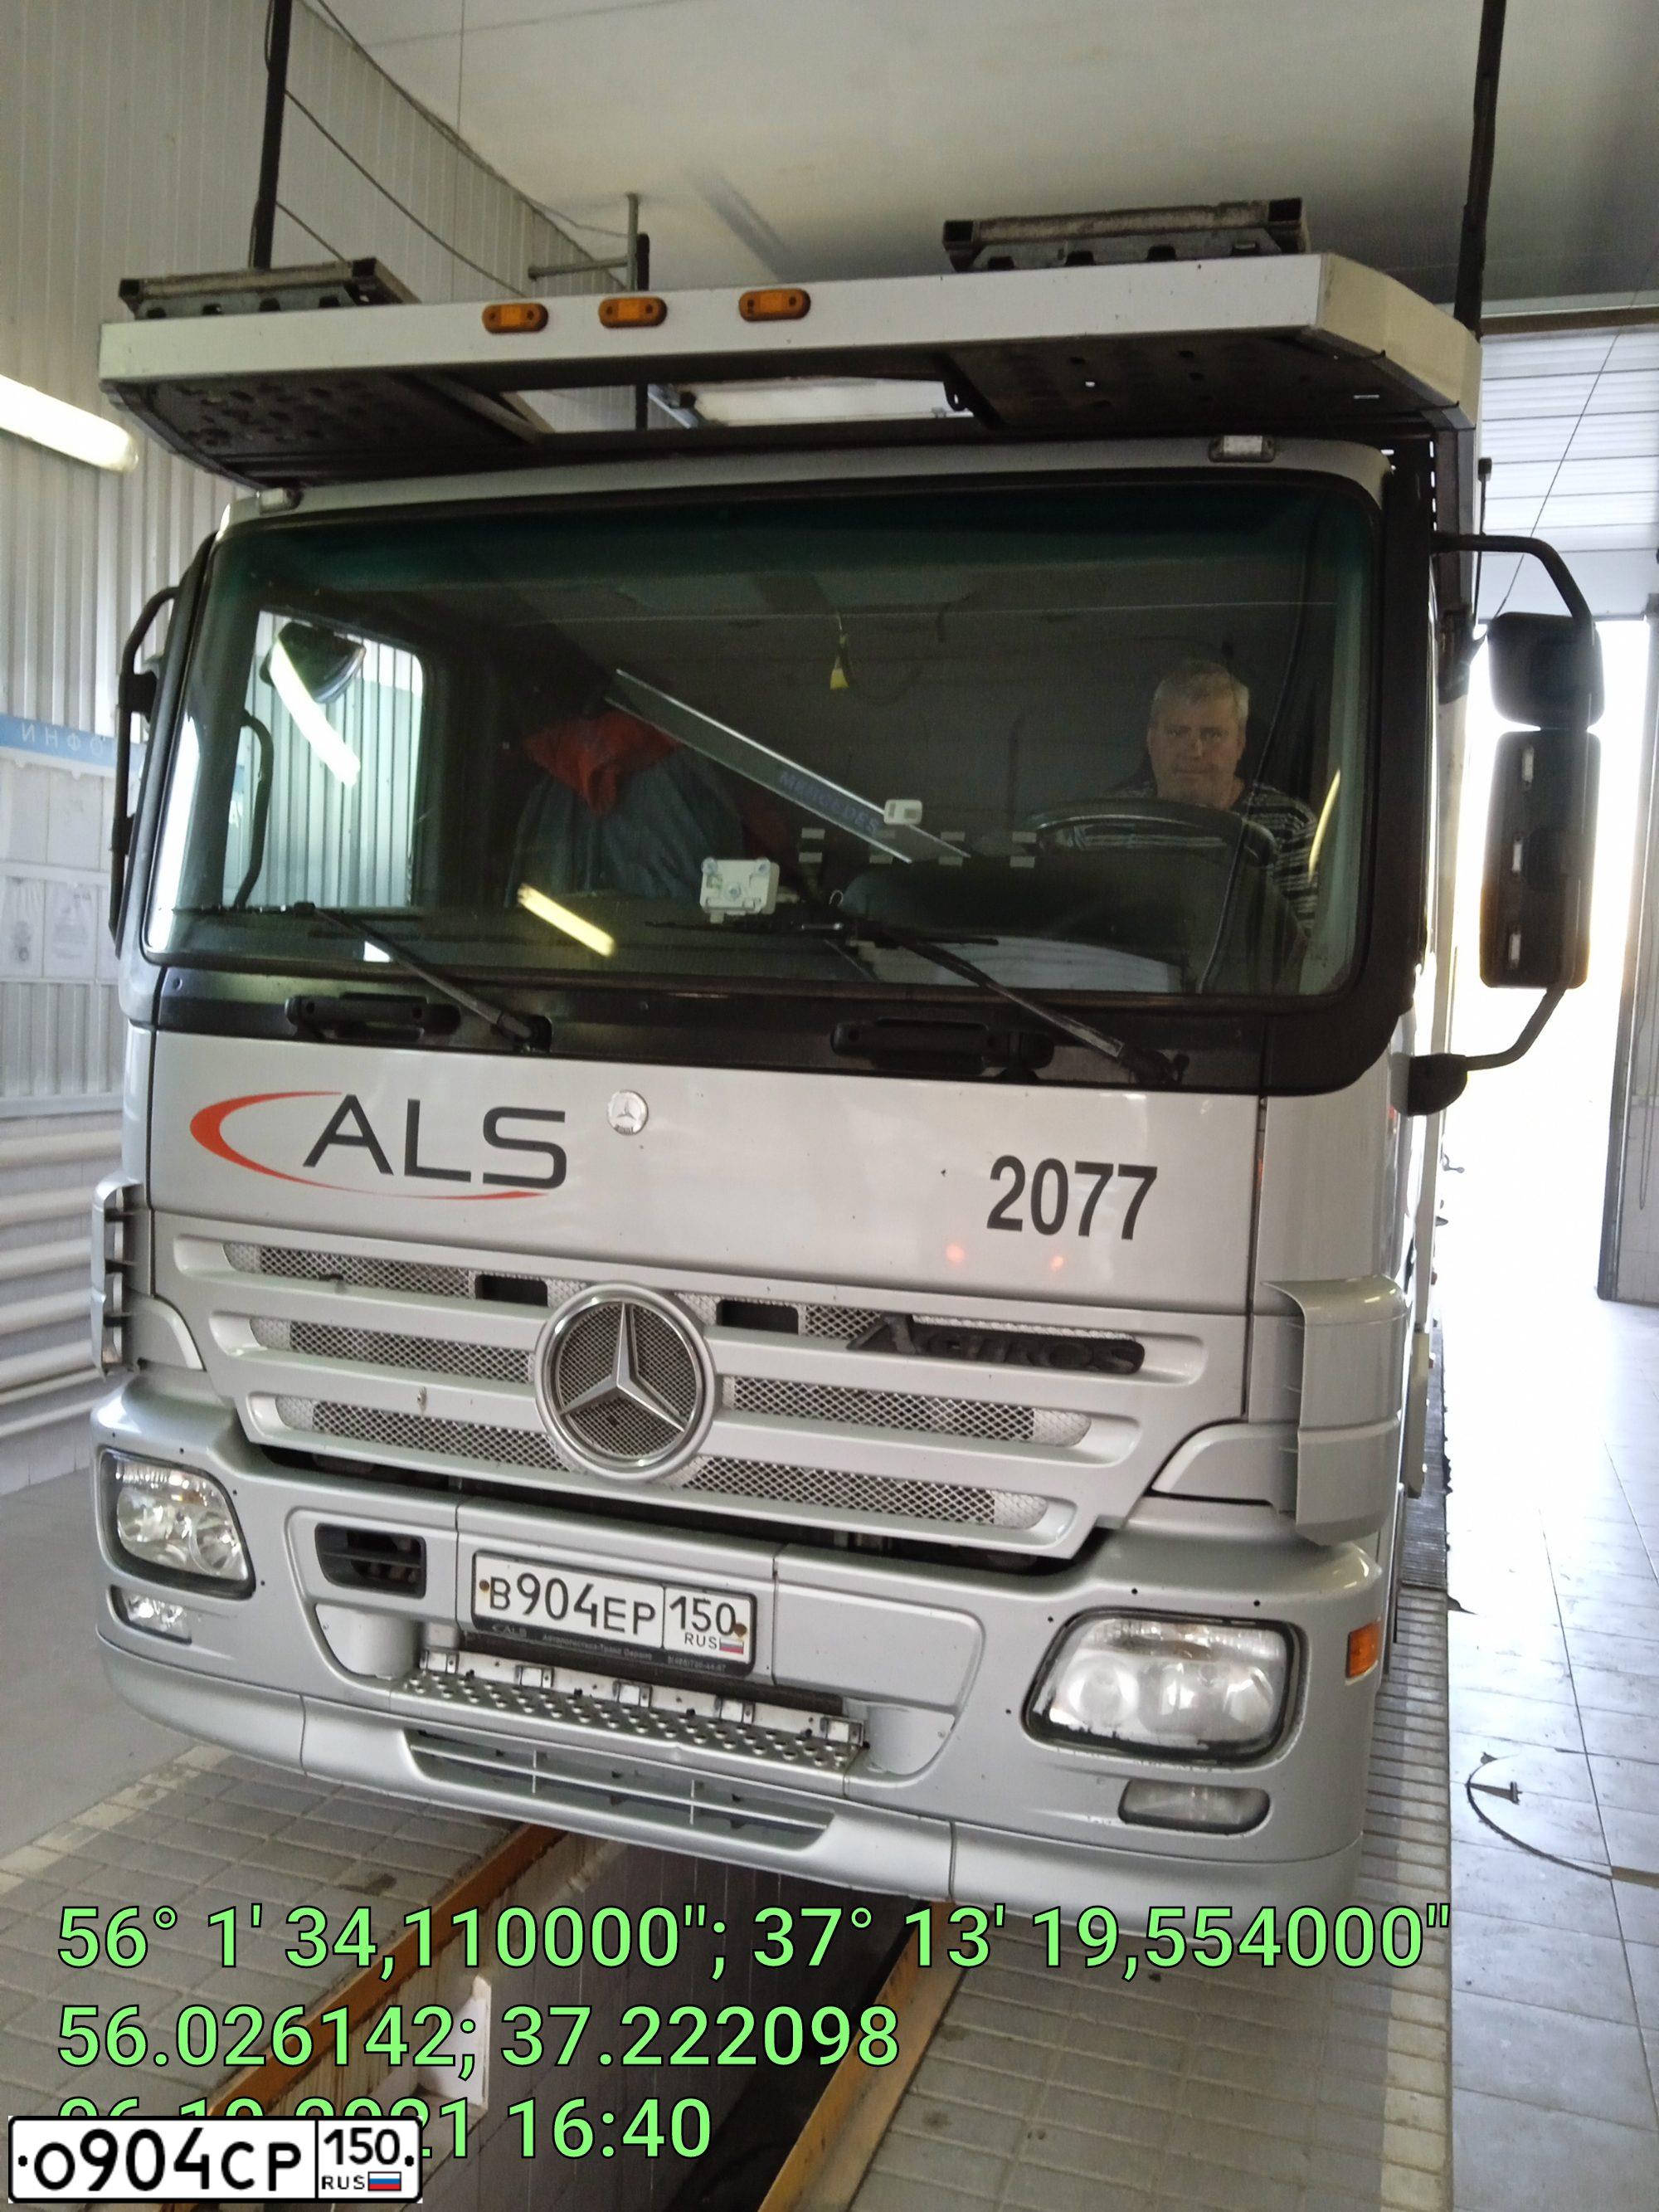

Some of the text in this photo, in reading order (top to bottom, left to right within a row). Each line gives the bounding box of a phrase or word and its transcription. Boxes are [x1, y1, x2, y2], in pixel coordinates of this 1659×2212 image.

[302, 1094, 567, 1190] ALS
[986, 1154, 1158, 1240] 2077
[669, 1595, 737, 1637] 150
[684, 1631, 718, 1650] RUS
